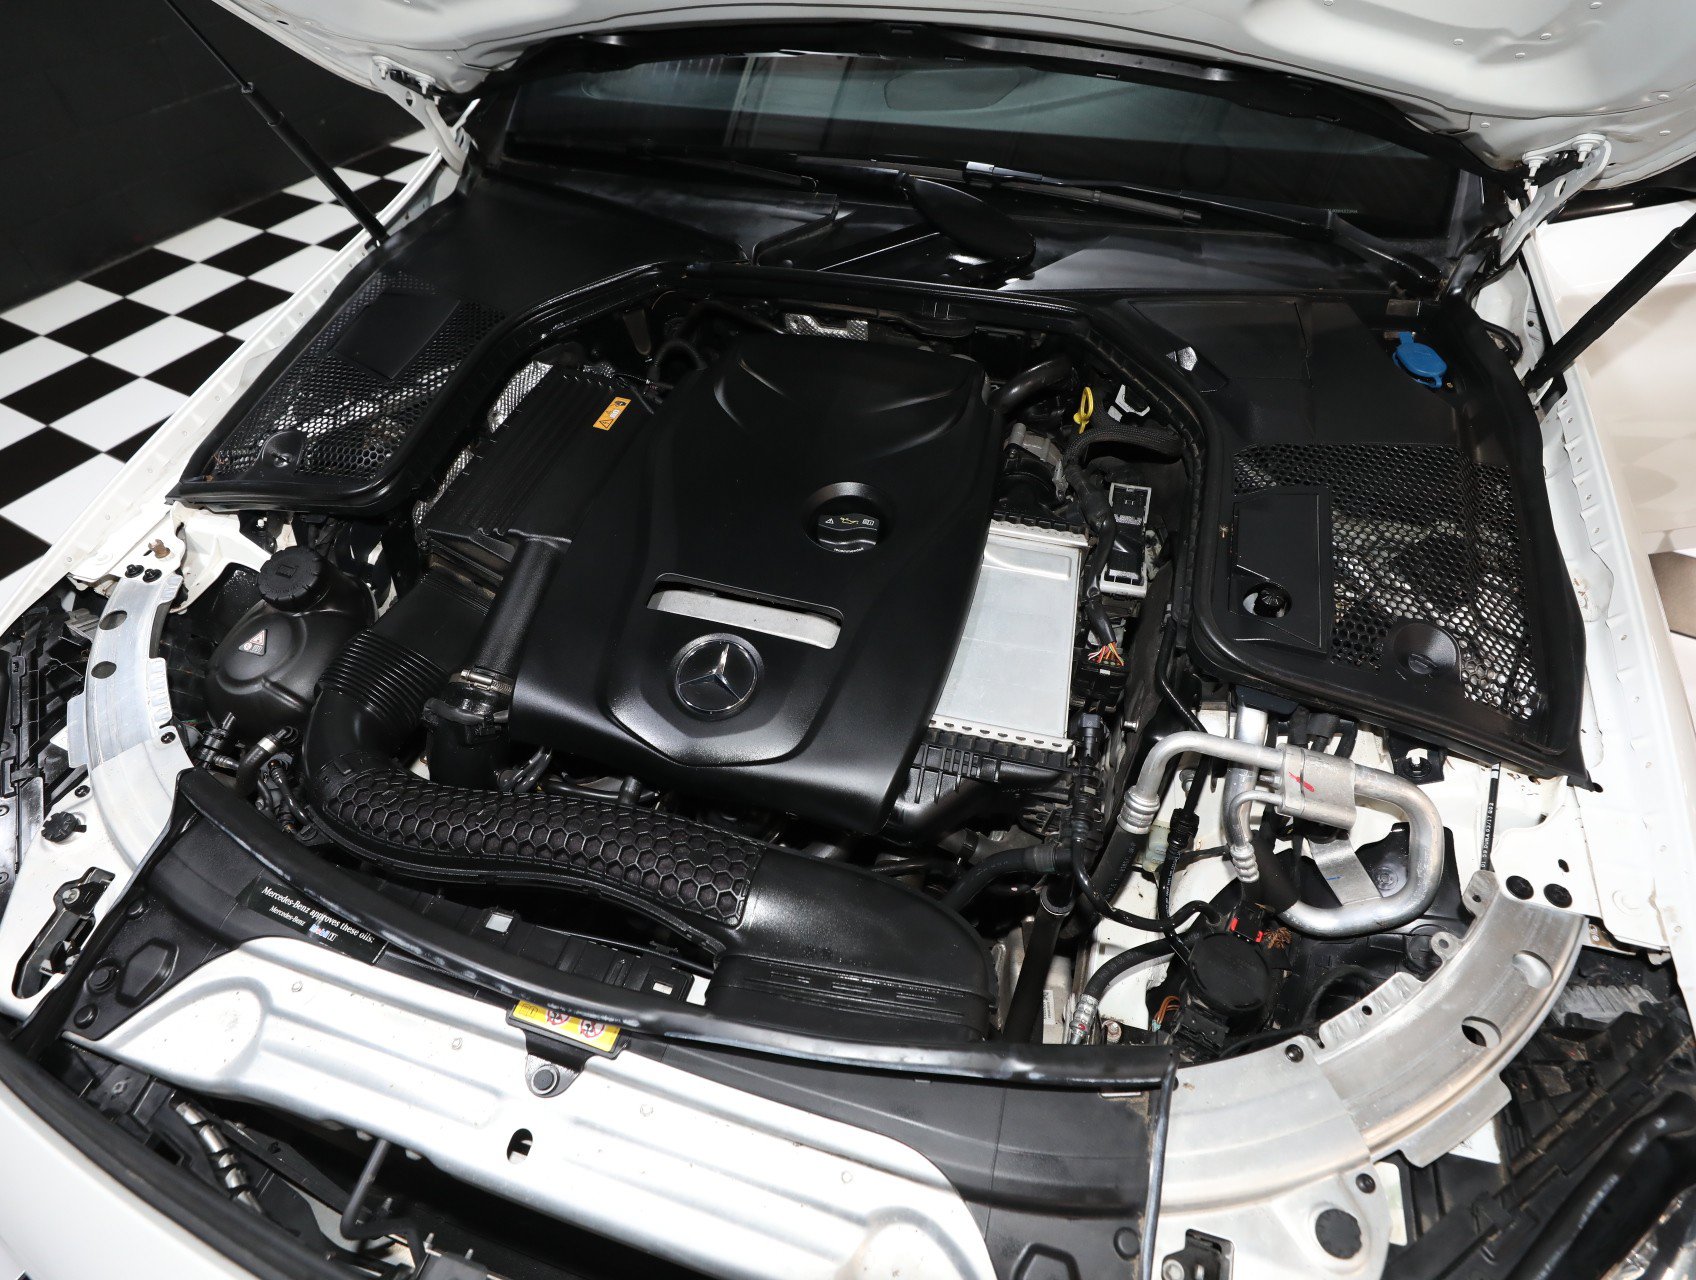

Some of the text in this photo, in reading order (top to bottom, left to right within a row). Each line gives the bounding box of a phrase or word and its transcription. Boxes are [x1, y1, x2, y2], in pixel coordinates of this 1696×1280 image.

[261, 886, 375, 943] Mercedes-Benz approves these oils:
[269, 905, 306, 927] Mercedes-Benz
